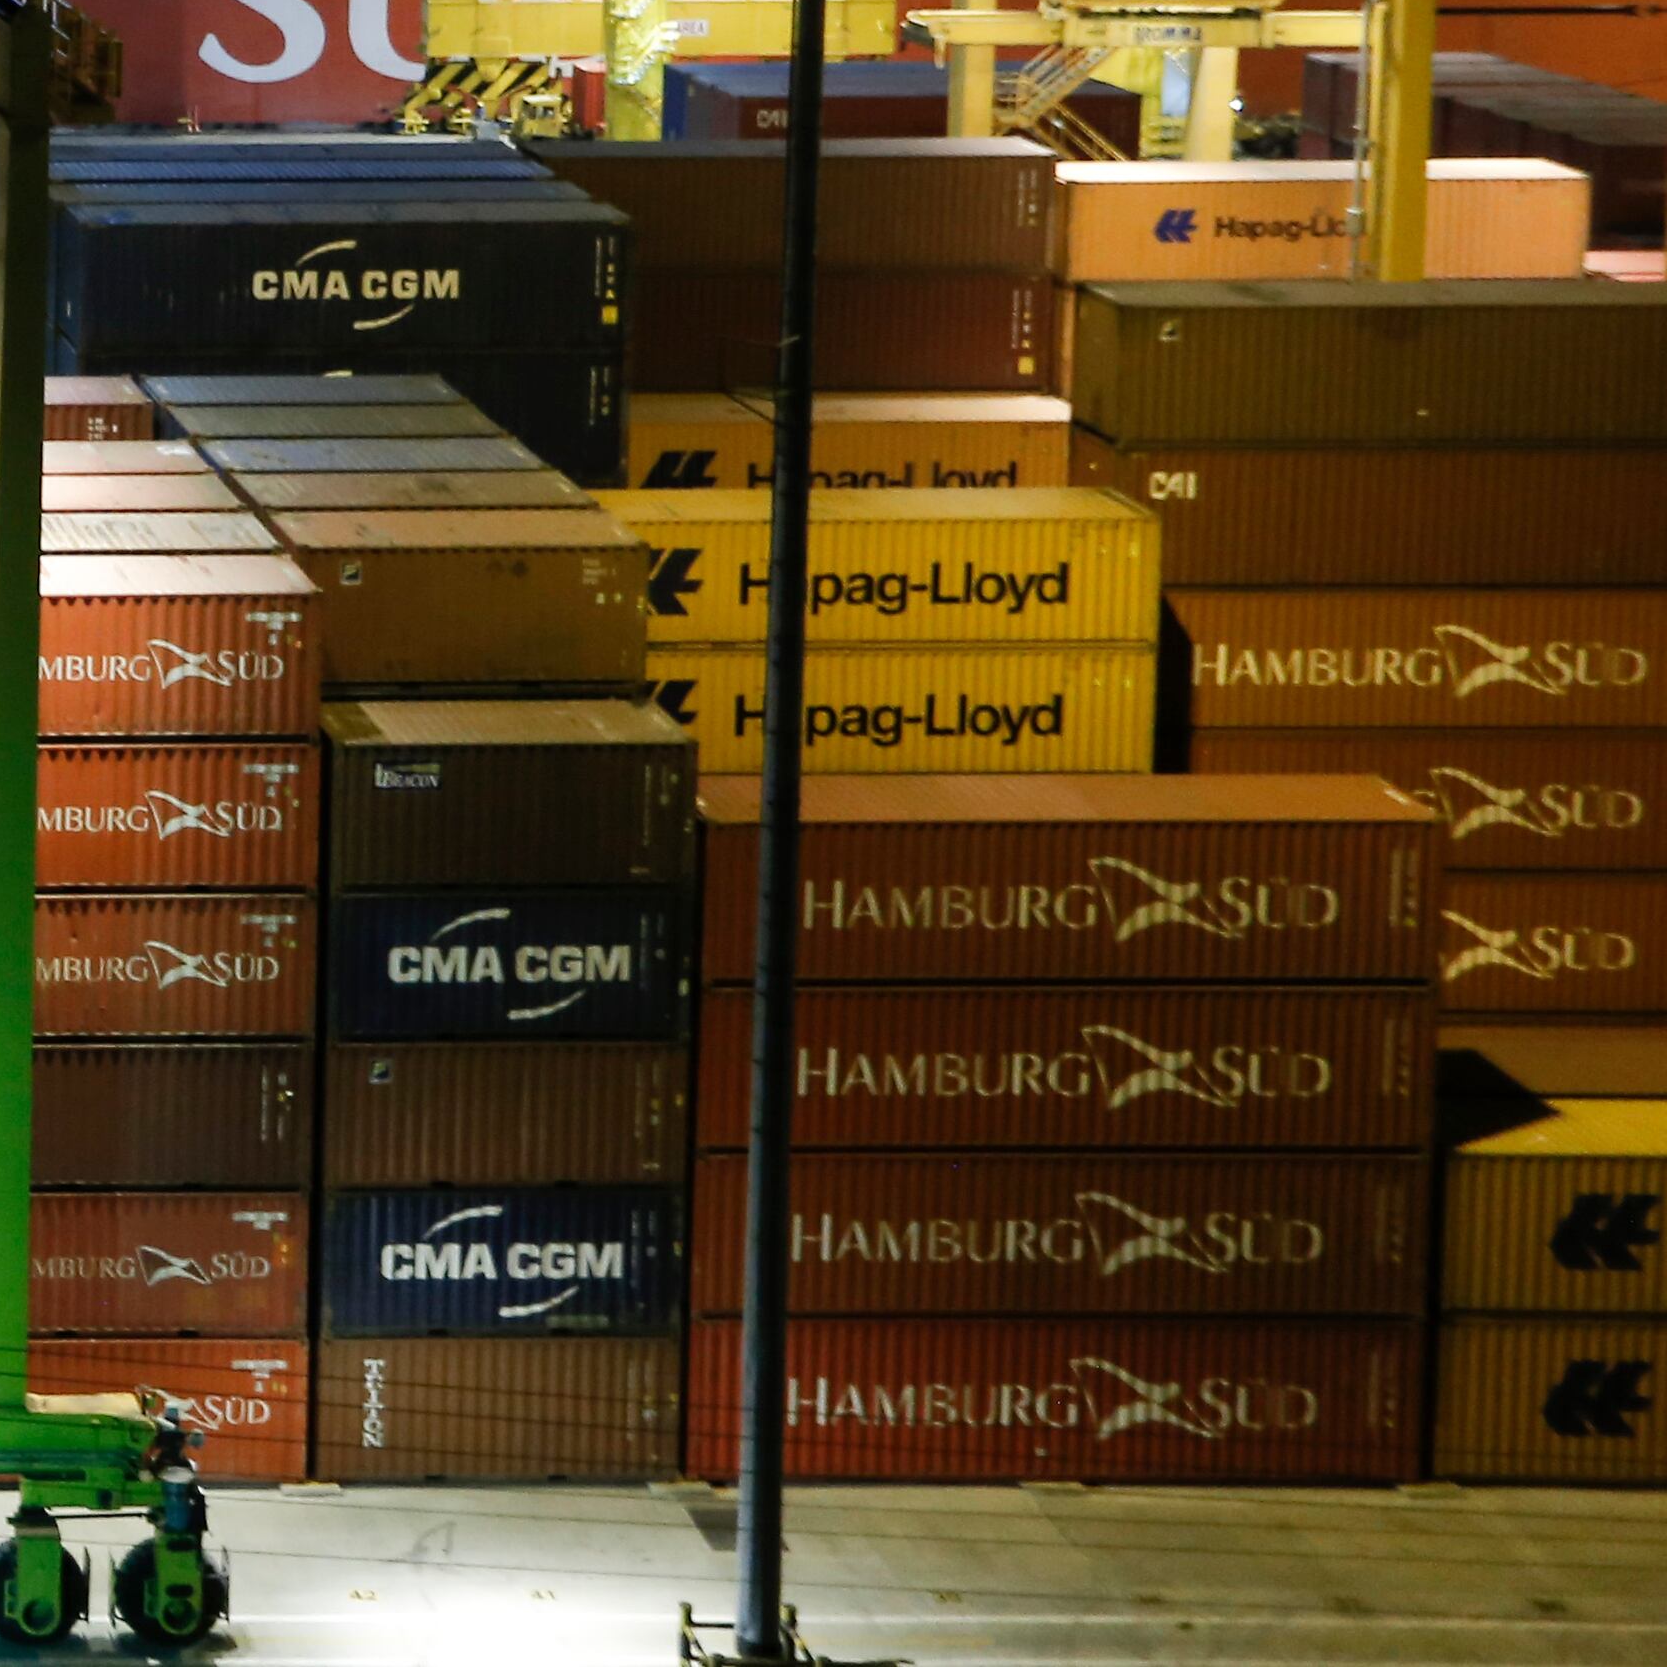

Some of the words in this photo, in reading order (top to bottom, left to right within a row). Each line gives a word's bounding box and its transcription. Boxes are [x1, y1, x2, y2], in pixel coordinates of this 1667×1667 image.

[252, 270, 349, 299] CMA
[362, 270, 459, 299] CGM
[1149, 471, 1197, 500] CAI
[740, 561, 1068, 615] Hpag-Lloyd
[38, 655, 151, 681] MBURG
[218, 650, 284, 683] SÜD
[1192, 641, 1442, 688] HAMBURG
[1547, 640, 1647, 686] SÜD
[734, 695, 1064, 745] Hpag-Lloyd
[37, 806, 149, 833] MBURG
[218, 801, 281, 832] SÜD
[1539, 784, 1644, 830] SÜD
[803, 879, 1099, 931] HAMBURG
[1220, 875, 1339, 929] SÜD
[37, 956, 149, 982] MBURG
[216, 952, 278, 982] SÜD
[389, 947, 502, 983] CMA
[516, 946, 631, 982] CGM
[1532, 926, 1635, 971] SÜD
[796, 1047, 1089, 1098] HAMBURG
[1211, 1045, 1331, 1096] SÜD
[790, 1213, 1083, 1263] HAMBURG
[1203, 1211, 1324, 1263] SÜD
[32, 1254, 135, 1279] MBURG
[211, 1252, 269, 1277] SÜD
[381, 1244, 495, 1279] CMA
[508, 1243, 623, 1279] CGM
[210, 1395, 271, 1426] SÜD
[364, 1359, 383, 1447] TRITON
[785, 1377, 1079, 1427] HAMBURG
[1198, 1377, 1317, 1427] SÜD
